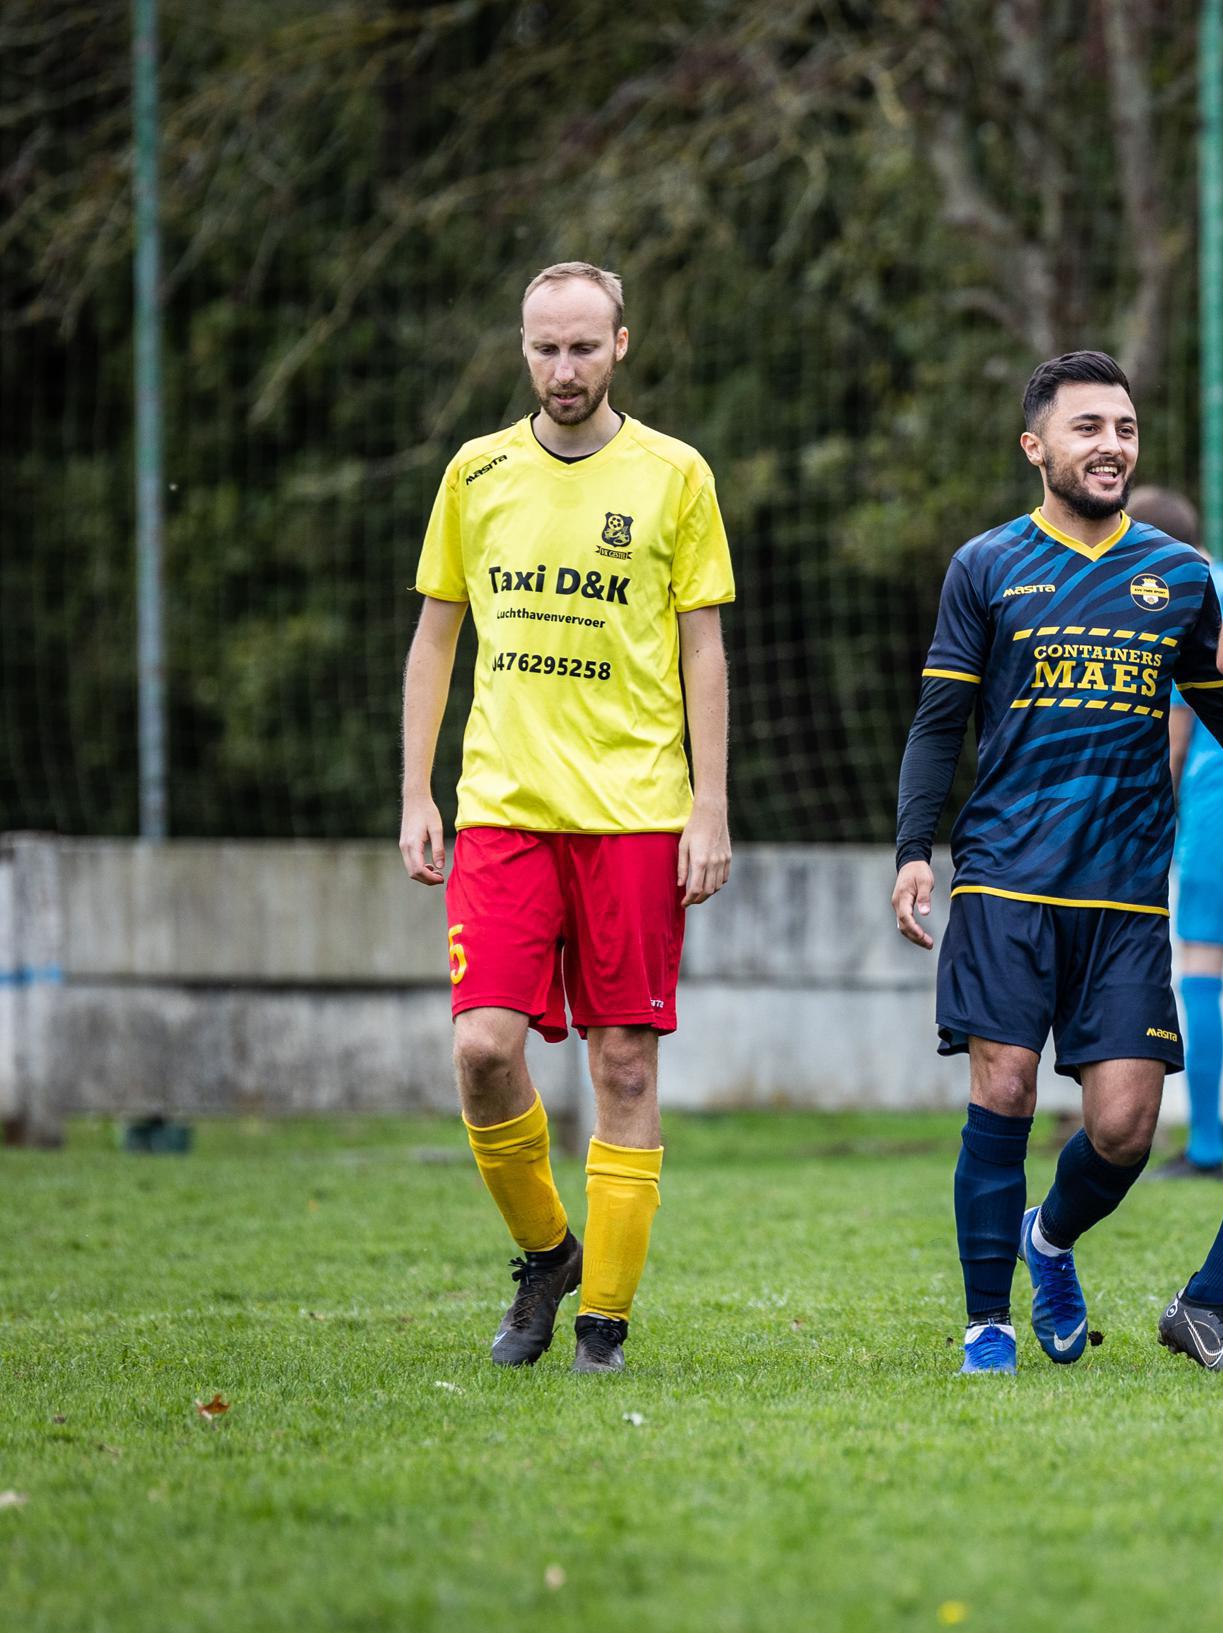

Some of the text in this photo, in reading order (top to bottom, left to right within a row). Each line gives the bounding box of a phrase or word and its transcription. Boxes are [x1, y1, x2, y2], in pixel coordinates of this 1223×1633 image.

[488, 564, 630, 605] Taxi D&K
[496, 607, 606, 628] Luchthavenvervoer
[1033, 643, 1163, 667] CONTAINERS
[1031, 660, 1158, 697] MAES
[448, 923, 468, 985] 5
